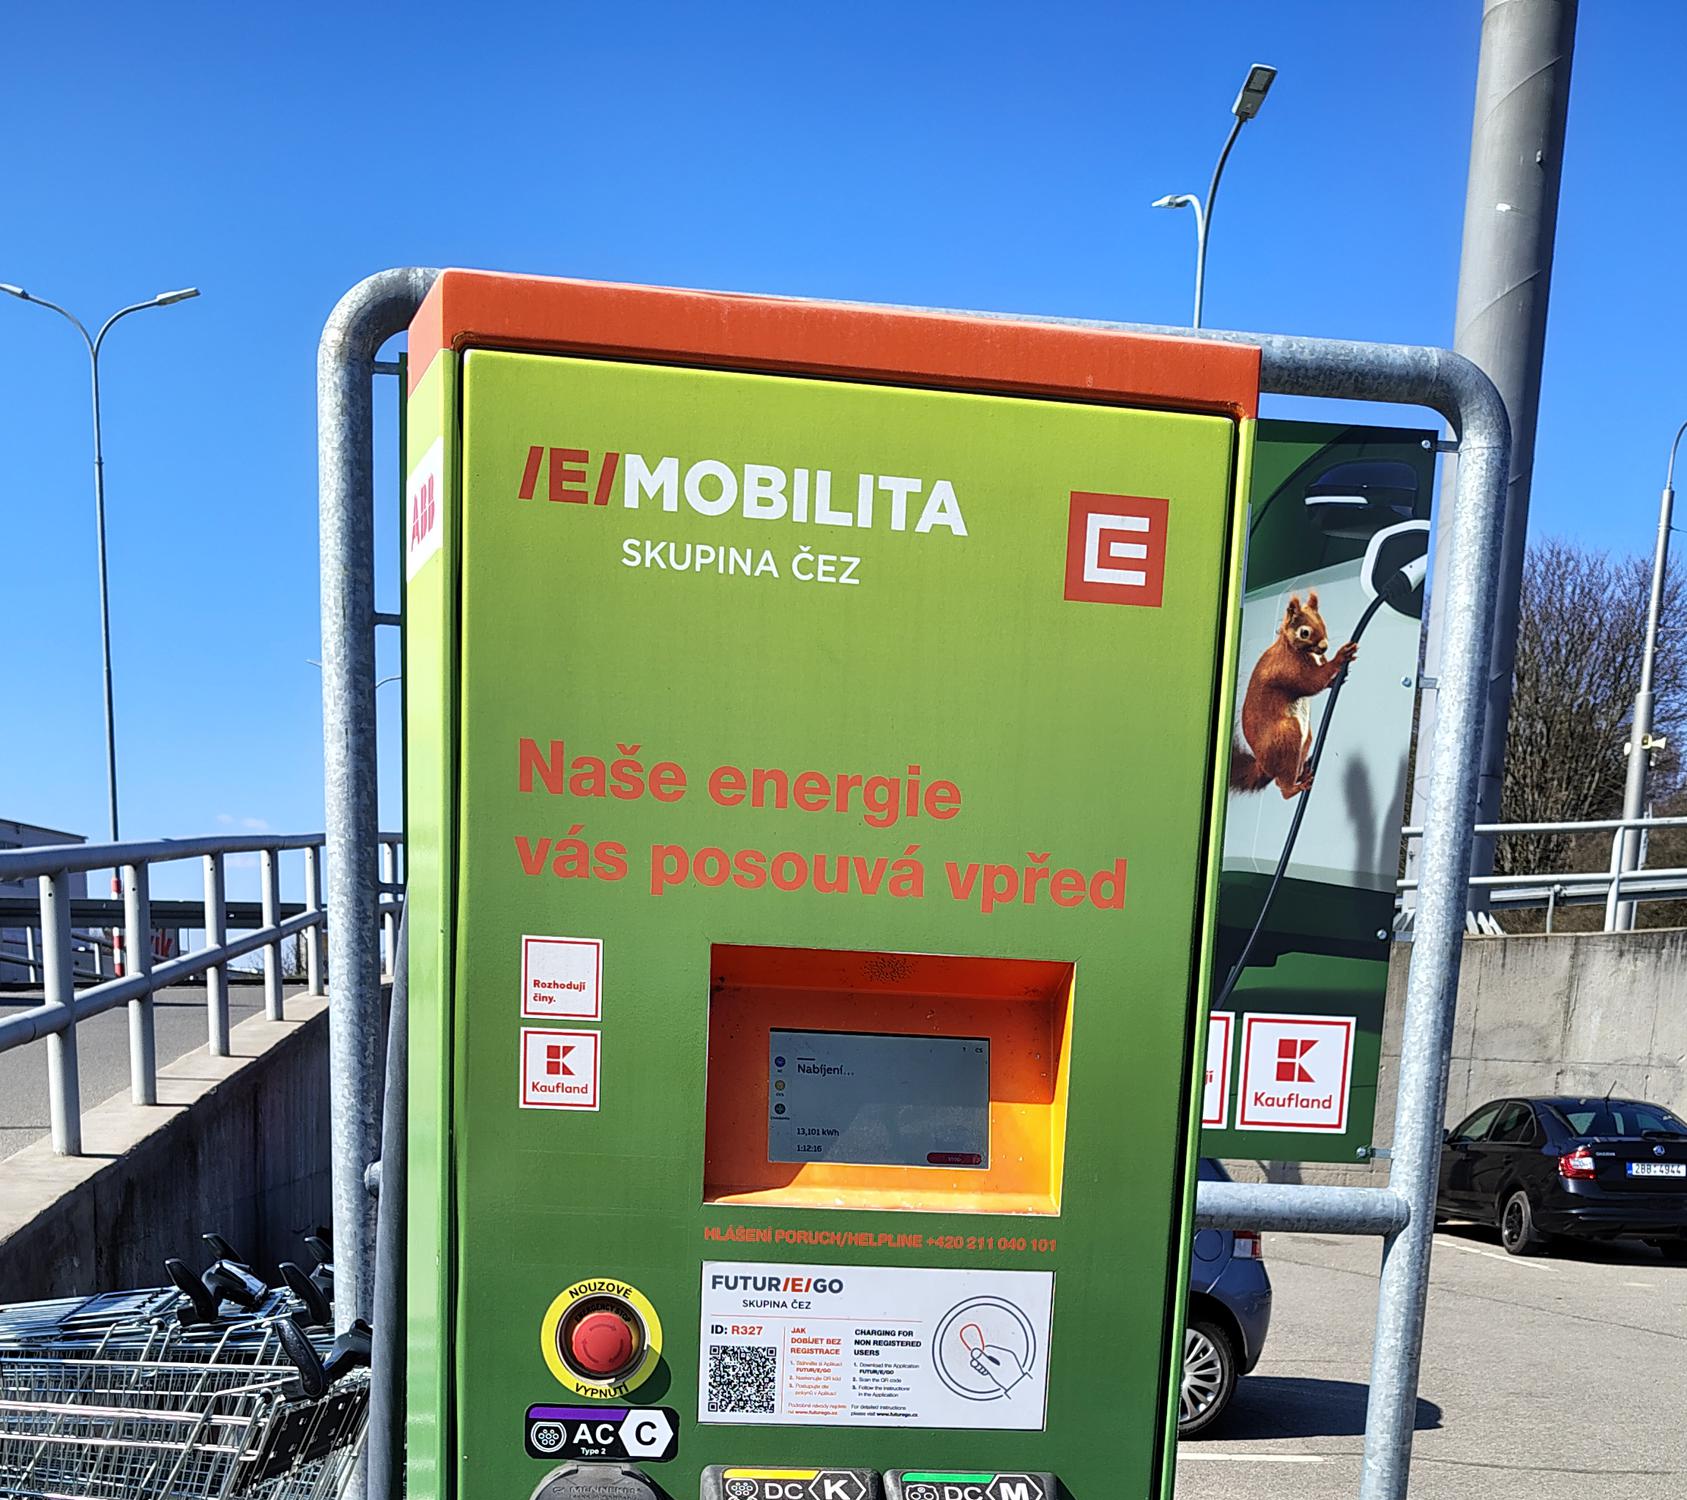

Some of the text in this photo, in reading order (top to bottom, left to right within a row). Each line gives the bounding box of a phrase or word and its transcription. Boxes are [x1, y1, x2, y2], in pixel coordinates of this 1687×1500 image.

[411, 473, 435, 552] ABB
[620, 538, 861, 586] SKUPINA ČEZ
[518, 737, 962, 829] Naše energie
[515, 824, 1128, 913] vás posouvá vpřed
[532, 979, 586, 992] Rozhodují
[532, 992, 556, 1004] činy.
[531, 1081, 588, 1094] Kaufland
[1253, 1091, 1333, 1109] Kaufland
[797, 1127, 840, 1136] 13,101 kWh
[704, 1225, 1057, 1252] HLÁŠENÍ PORUCH/HELPLINE +420 211 040 101
[568, 1281, 633, 1299] NOUZOVÉ
[712, 1275, 844, 1294] FUTUR/E/GO
[742, 1299, 811, 1310] SKUPINA ČEZ
[710, 1325, 763, 1336] ID: R327
[854, 1329, 896, 1337] CHARGING
[790, 1347, 840, 1355] REGISTRACE
[872, 1340, 922, 1348] REGISTERED
[575, 1382, 630, 1398] VYPNUTÍ
[572, 1421, 657, 1446] AC C
[580, 1447, 599, 1455] Type
[764, 1479, 851, 1500] DC K
